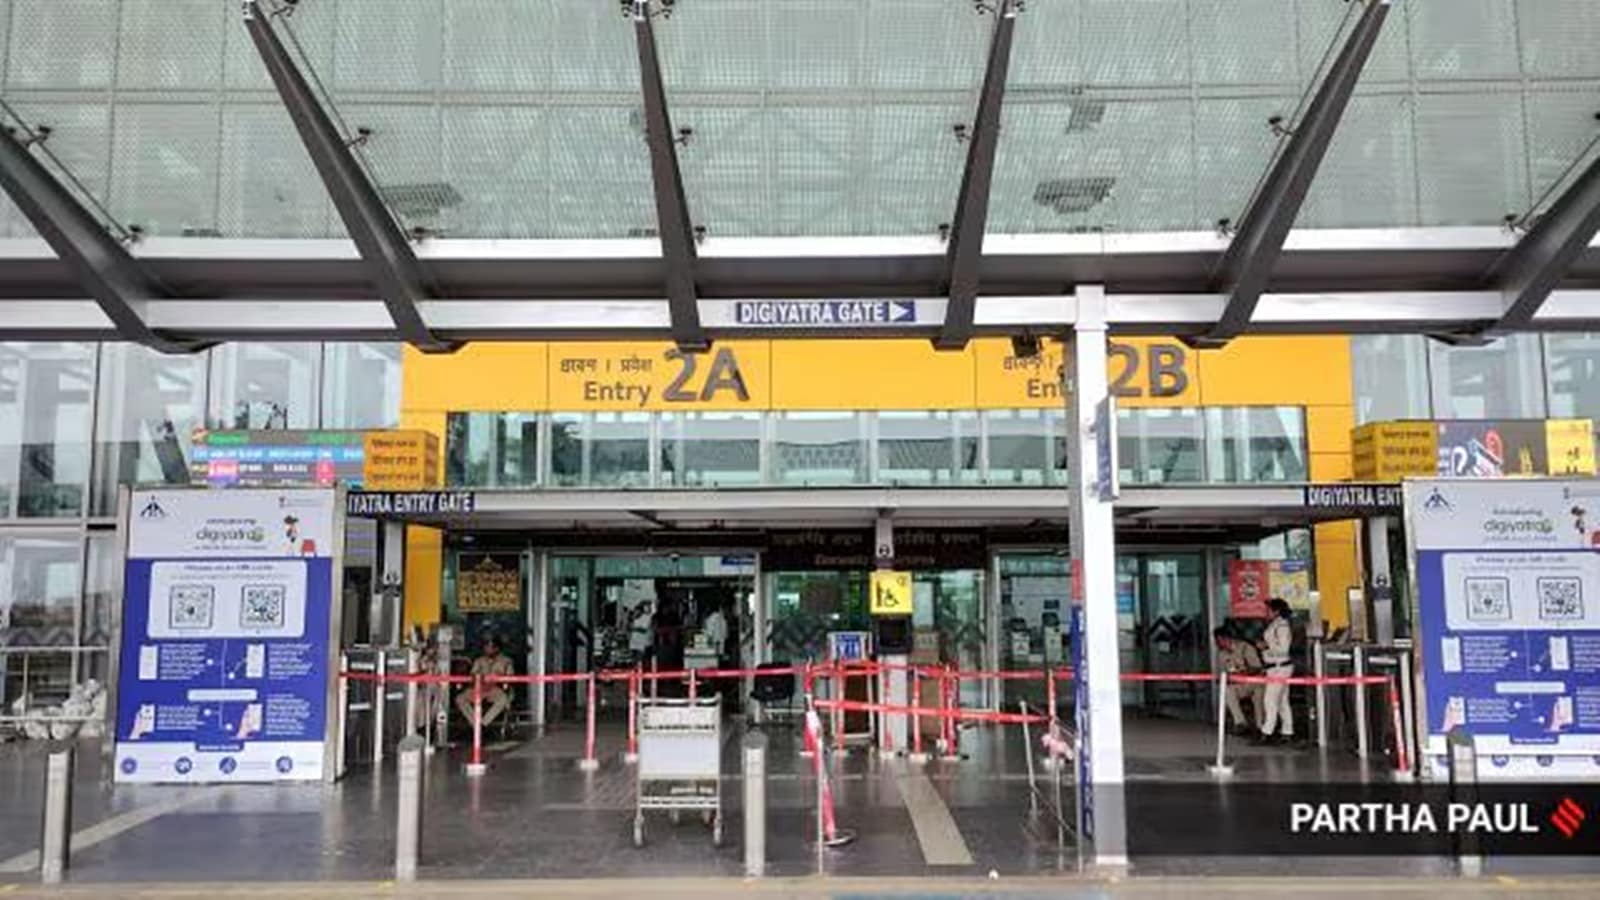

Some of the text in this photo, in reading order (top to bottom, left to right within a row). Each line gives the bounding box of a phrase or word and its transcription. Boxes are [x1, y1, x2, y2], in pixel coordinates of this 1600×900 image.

[741, 302, 884, 322] DIGIYATRA GATE
[662, 347, 750, 402] 2A
[1107, 343, 1189, 398] 2B
[583, 380, 652, 408] Entry
[394, 493, 435, 512] ENTRY
[438, 491, 472, 512] GATE
[1308, 487, 1375, 506] DIGIYATRA
